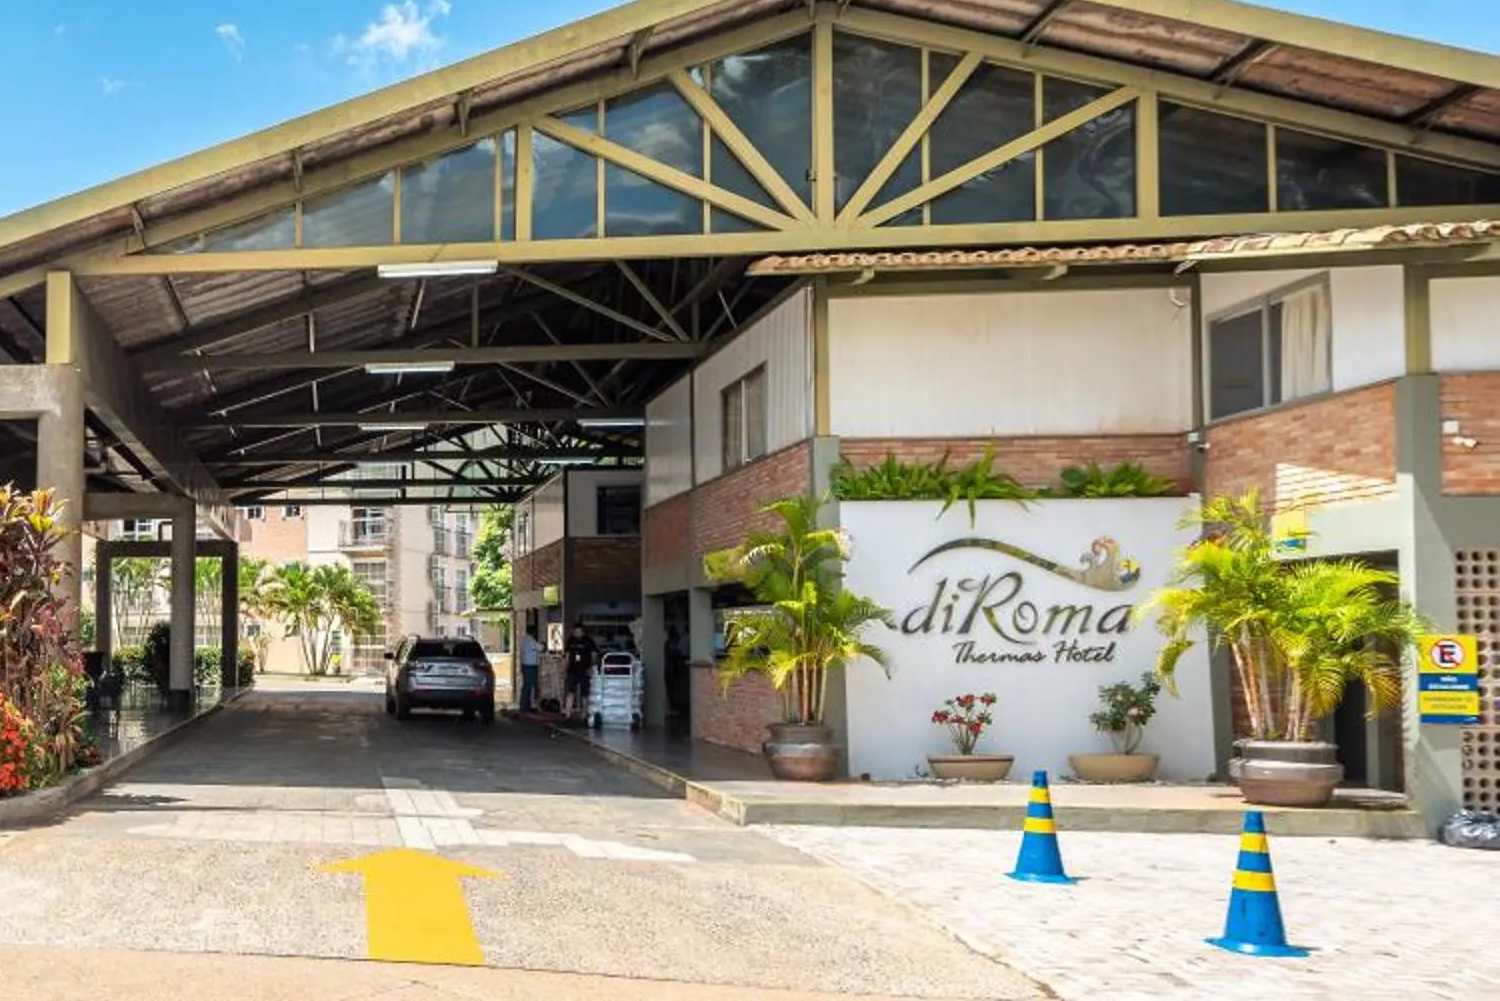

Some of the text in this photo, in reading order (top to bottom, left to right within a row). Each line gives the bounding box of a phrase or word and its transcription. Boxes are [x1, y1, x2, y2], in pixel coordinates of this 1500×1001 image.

[901, 571, 1135, 645] diRoma
[952, 641, 1117, 664] Thermas Hotel
[1440, 645, 1457, 664] E
